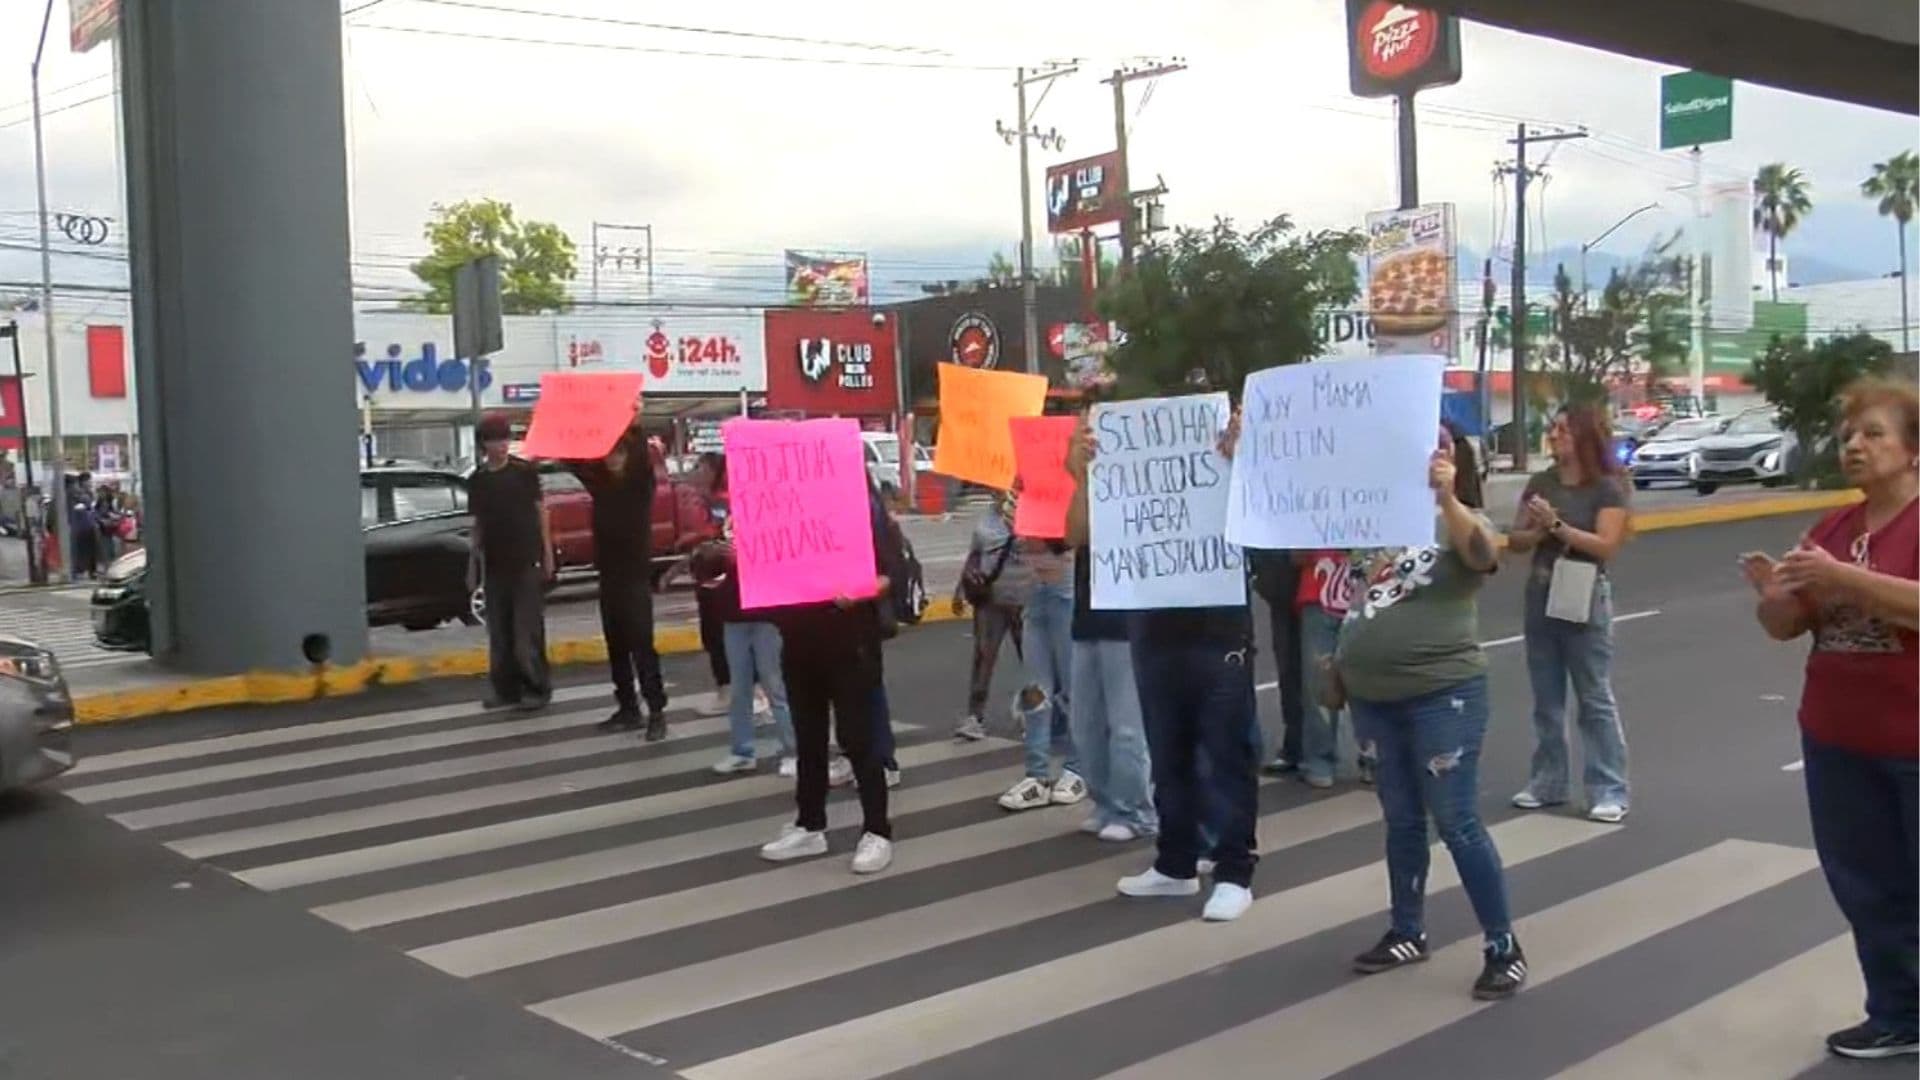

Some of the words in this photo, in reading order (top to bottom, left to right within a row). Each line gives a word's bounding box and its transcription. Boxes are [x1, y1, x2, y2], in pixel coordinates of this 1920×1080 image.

[1372, 19, 1421, 57] Pizza
[1381, 36, 1412, 62] Hut
[1076, 165, 1103, 189] CLUB
[836, 343, 872, 363] CLUB
[1098, 411, 1139, 455] SI
[1142, 406, 1176, 449] NO
[1180, 403, 1222, 444] HAY
